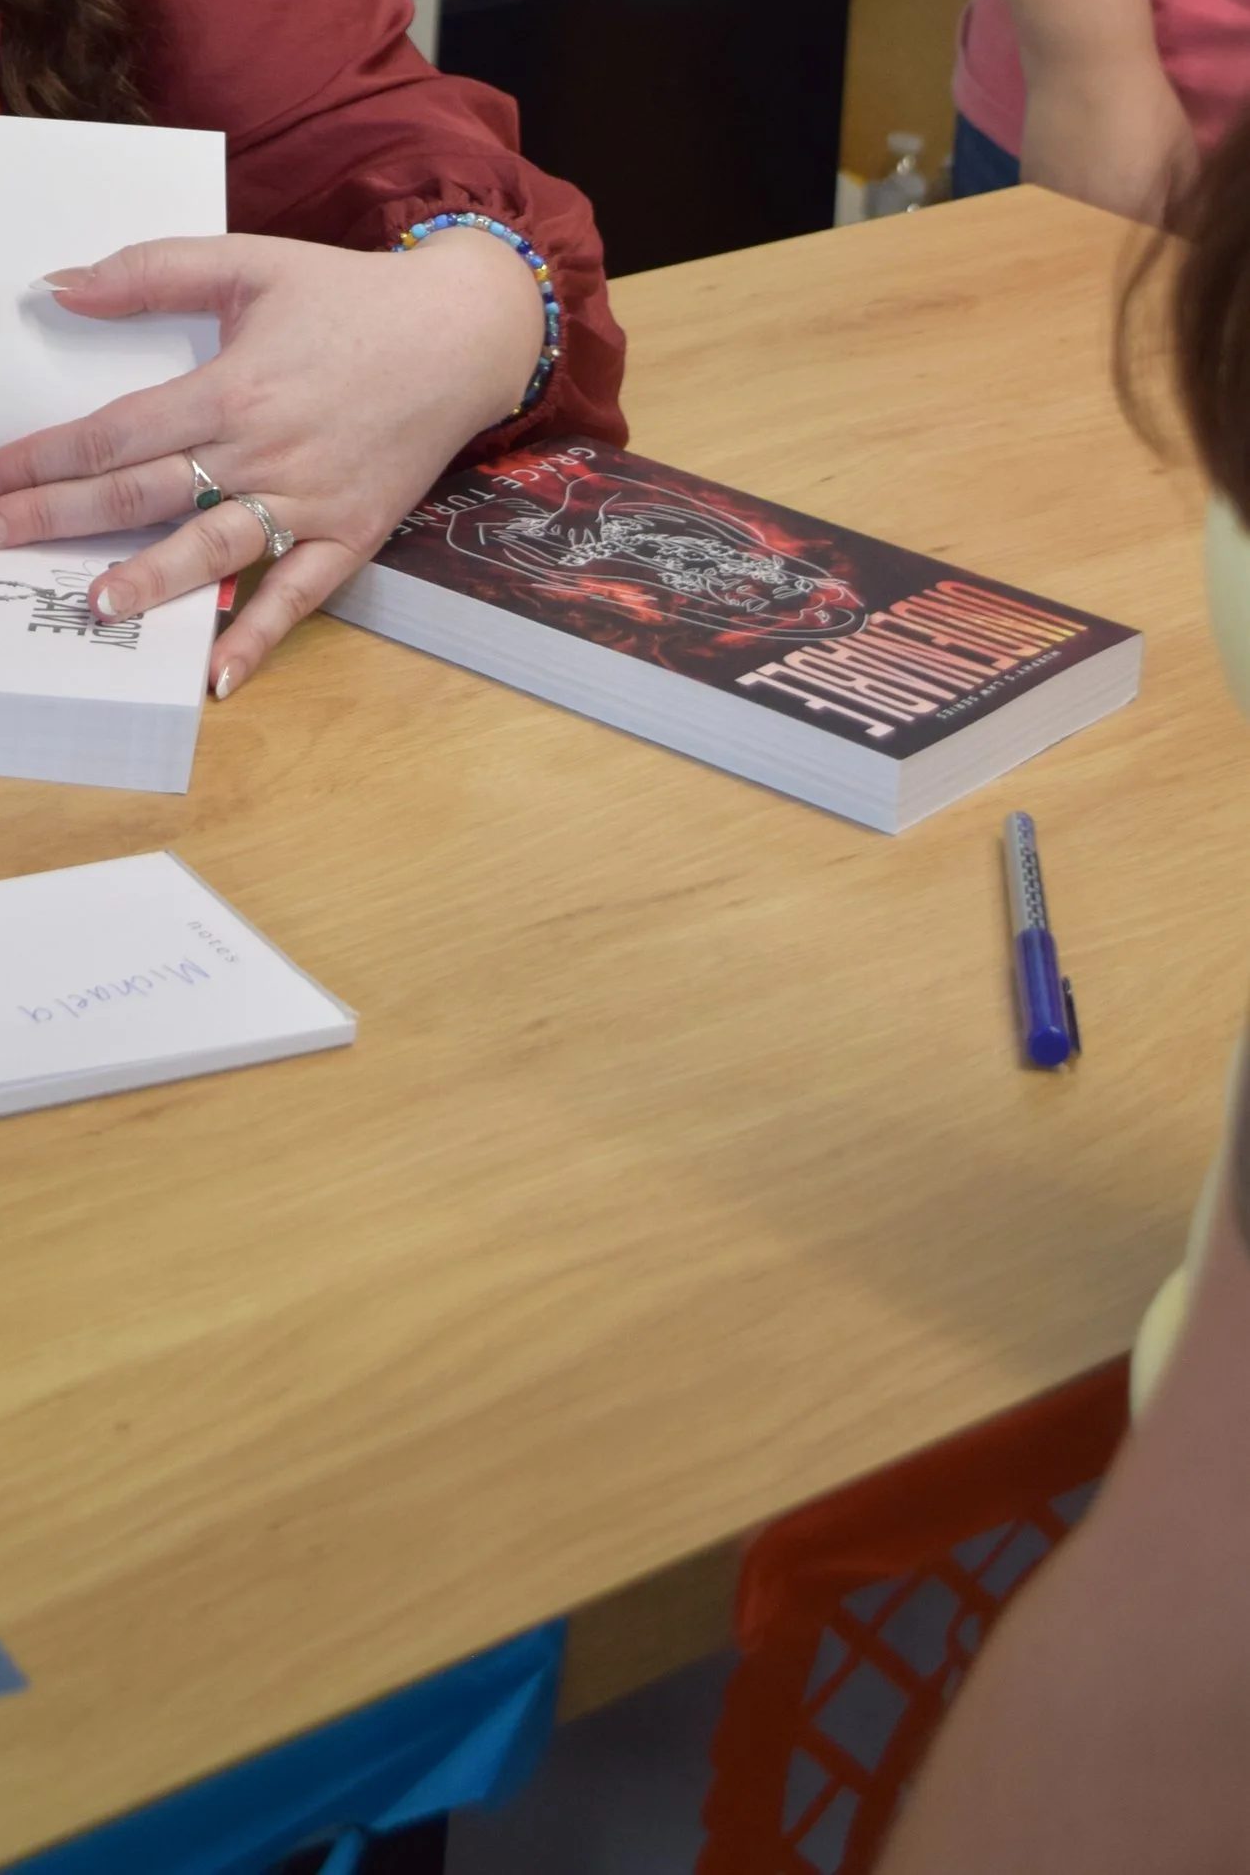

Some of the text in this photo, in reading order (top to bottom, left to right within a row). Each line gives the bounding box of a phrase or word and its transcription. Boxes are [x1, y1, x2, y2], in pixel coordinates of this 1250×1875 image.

[386, 446, 596, 541] GRACE TURNE
[28, 588, 91, 636] SAVE
[735, 579, 1089, 739] UNDENIABLE
[935, 650, 1062, 721] MURPHY'S LAW SERIES
[16, 955, 211, 1023] Michaela
